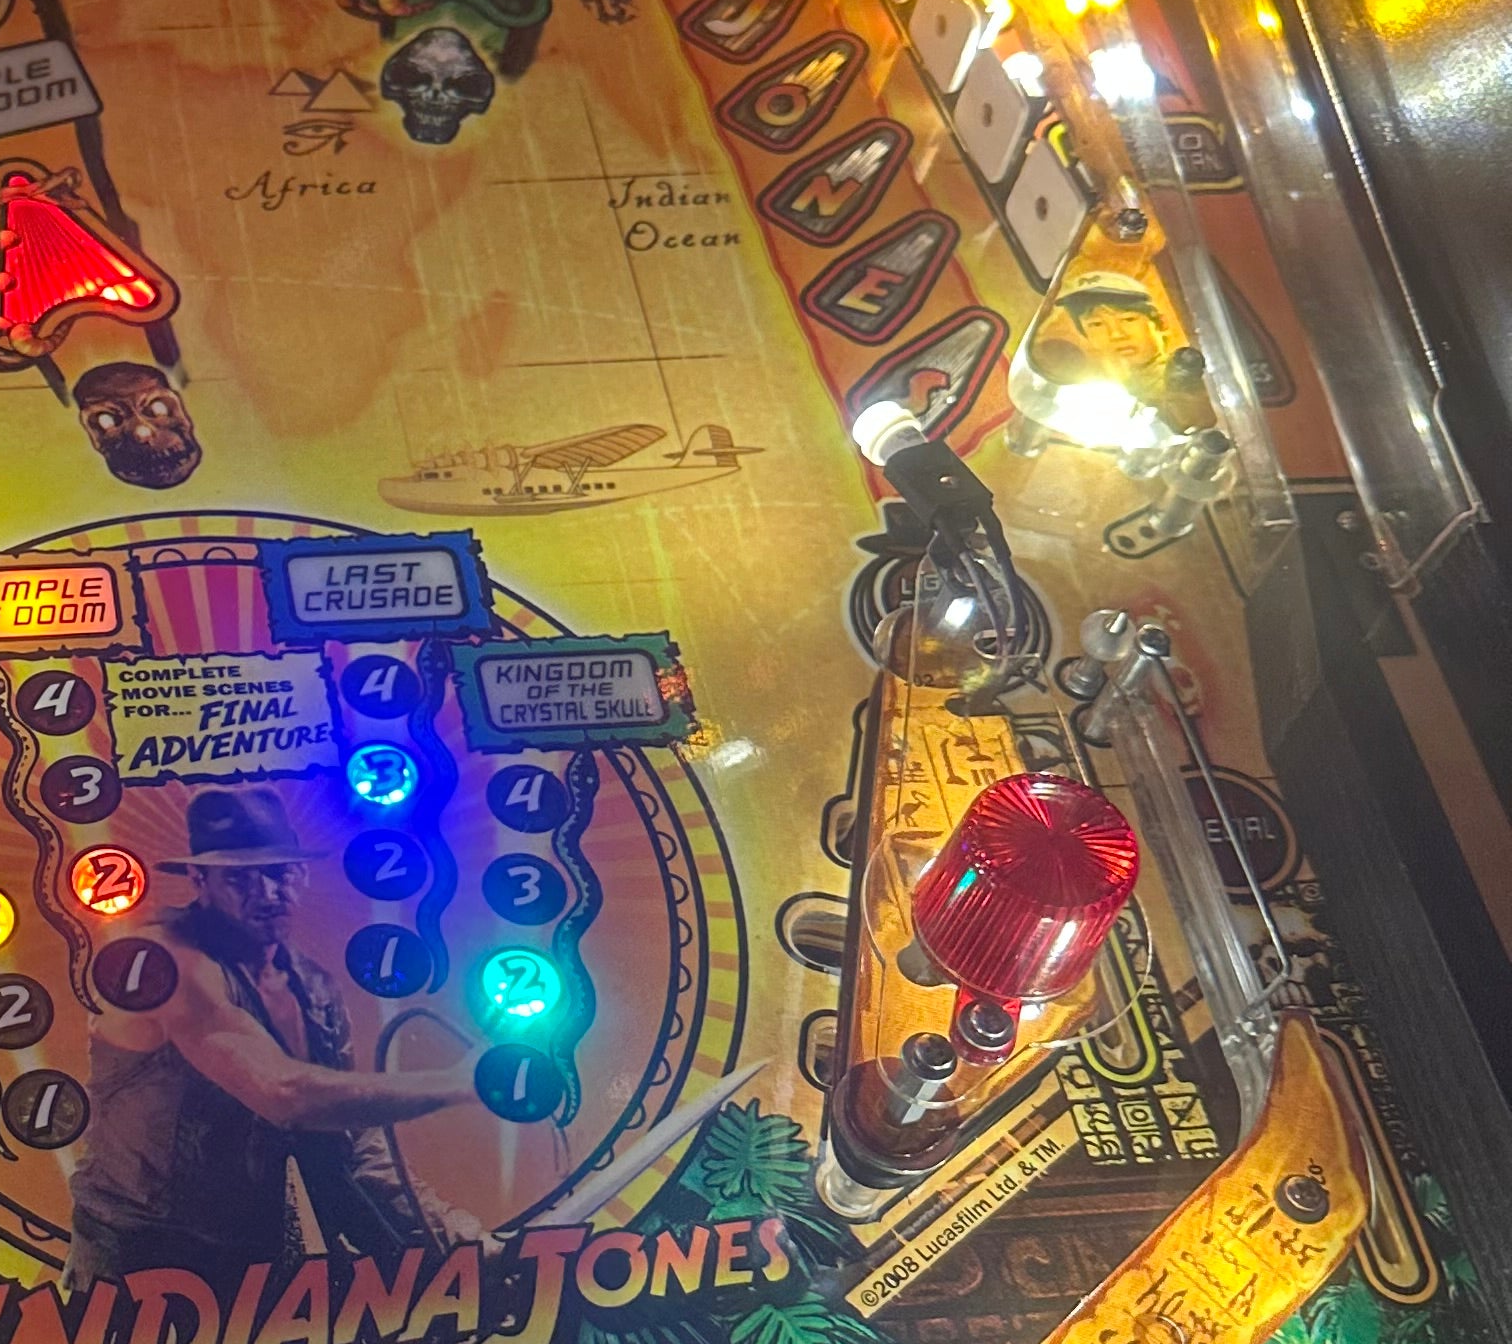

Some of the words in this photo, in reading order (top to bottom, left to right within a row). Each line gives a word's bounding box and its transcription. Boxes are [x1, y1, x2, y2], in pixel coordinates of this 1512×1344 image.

[224, 168, 379, 212] Africa
[607, 175, 731, 209] Indian
[623, 219, 741, 252] Ocean
[326, 561, 422, 587] LAST
[13, 602, 107, 628] DOOM
[304, 585, 455, 613] CRUSADE
[118, 665, 243, 684] COMPLETE
[121, 683, 197, 701] MOVIE
[202, 679, 295, 697] SCENES
[359, 664, 399, 703] 4
[496, 659, 634, 684] KINGDOM
[527, 683, 564, 700] OF
[567, 681, 614, 697] THE
[33, 678, 76, 718] 4
[124, 704, 192, 718] FOR...
[198, 696, 299, 732] FINAL
[500, 702, 588, 725] CRYSTAL
[595, 699, 654, 721] SKULL
[128, 722, 330, 772] ADVENTURE
[70, 765, 105, 808] 3
[505, 772, 545, 813] 4
[89, 852, 136, 900] 2
[374, 841, 408, 883] 2
[507, 864, 542, 903] 3
[126, 949, 148, 995] 1
[376, 934, 400, 979] 1
[506, 955, 545, 998] 2
[508, 1059, 530, 1102] 1
[36, 1082, 62, 1133] 1
[861, 1256, 920, 1308] ©2008
[916, 1200, 993, 1262] Lucasfilm
[985, 1174, 1023, 1203] Ltd.
[1018, 1159, 1038, 1178] &
